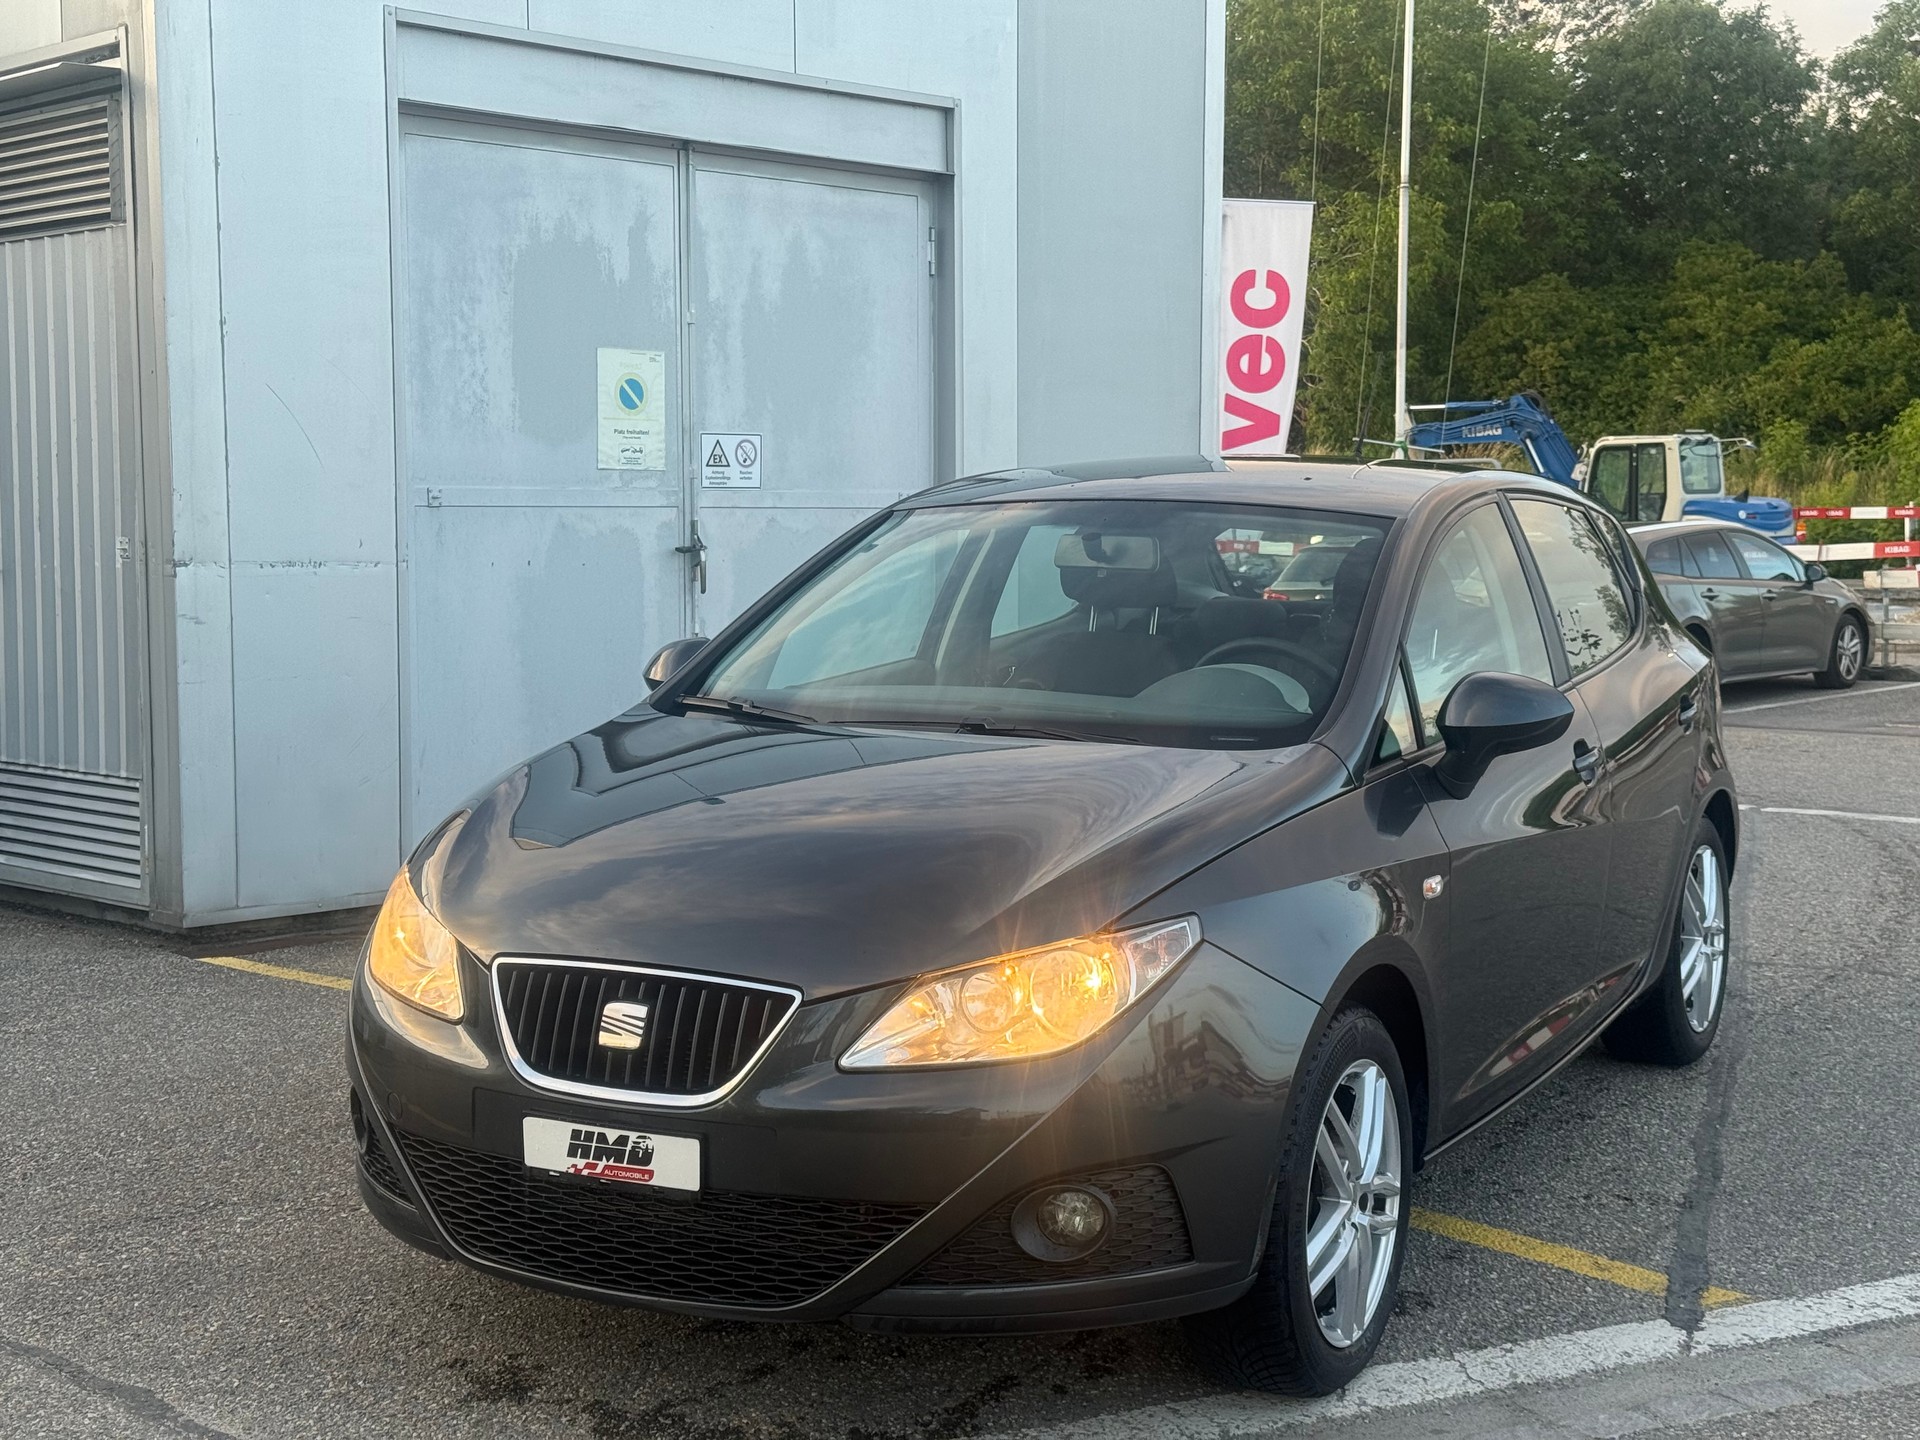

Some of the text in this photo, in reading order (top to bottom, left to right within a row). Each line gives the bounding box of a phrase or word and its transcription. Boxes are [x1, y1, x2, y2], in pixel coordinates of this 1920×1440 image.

[1221, 269, 1290, 451] vec
[1462, 426, 1502, 438] KIBAG
[713, 454, 723, 464] EX
[566, 1128, 655, 1167] HMD
[603, 1168, 650, 1181] AUTOMOBILE
